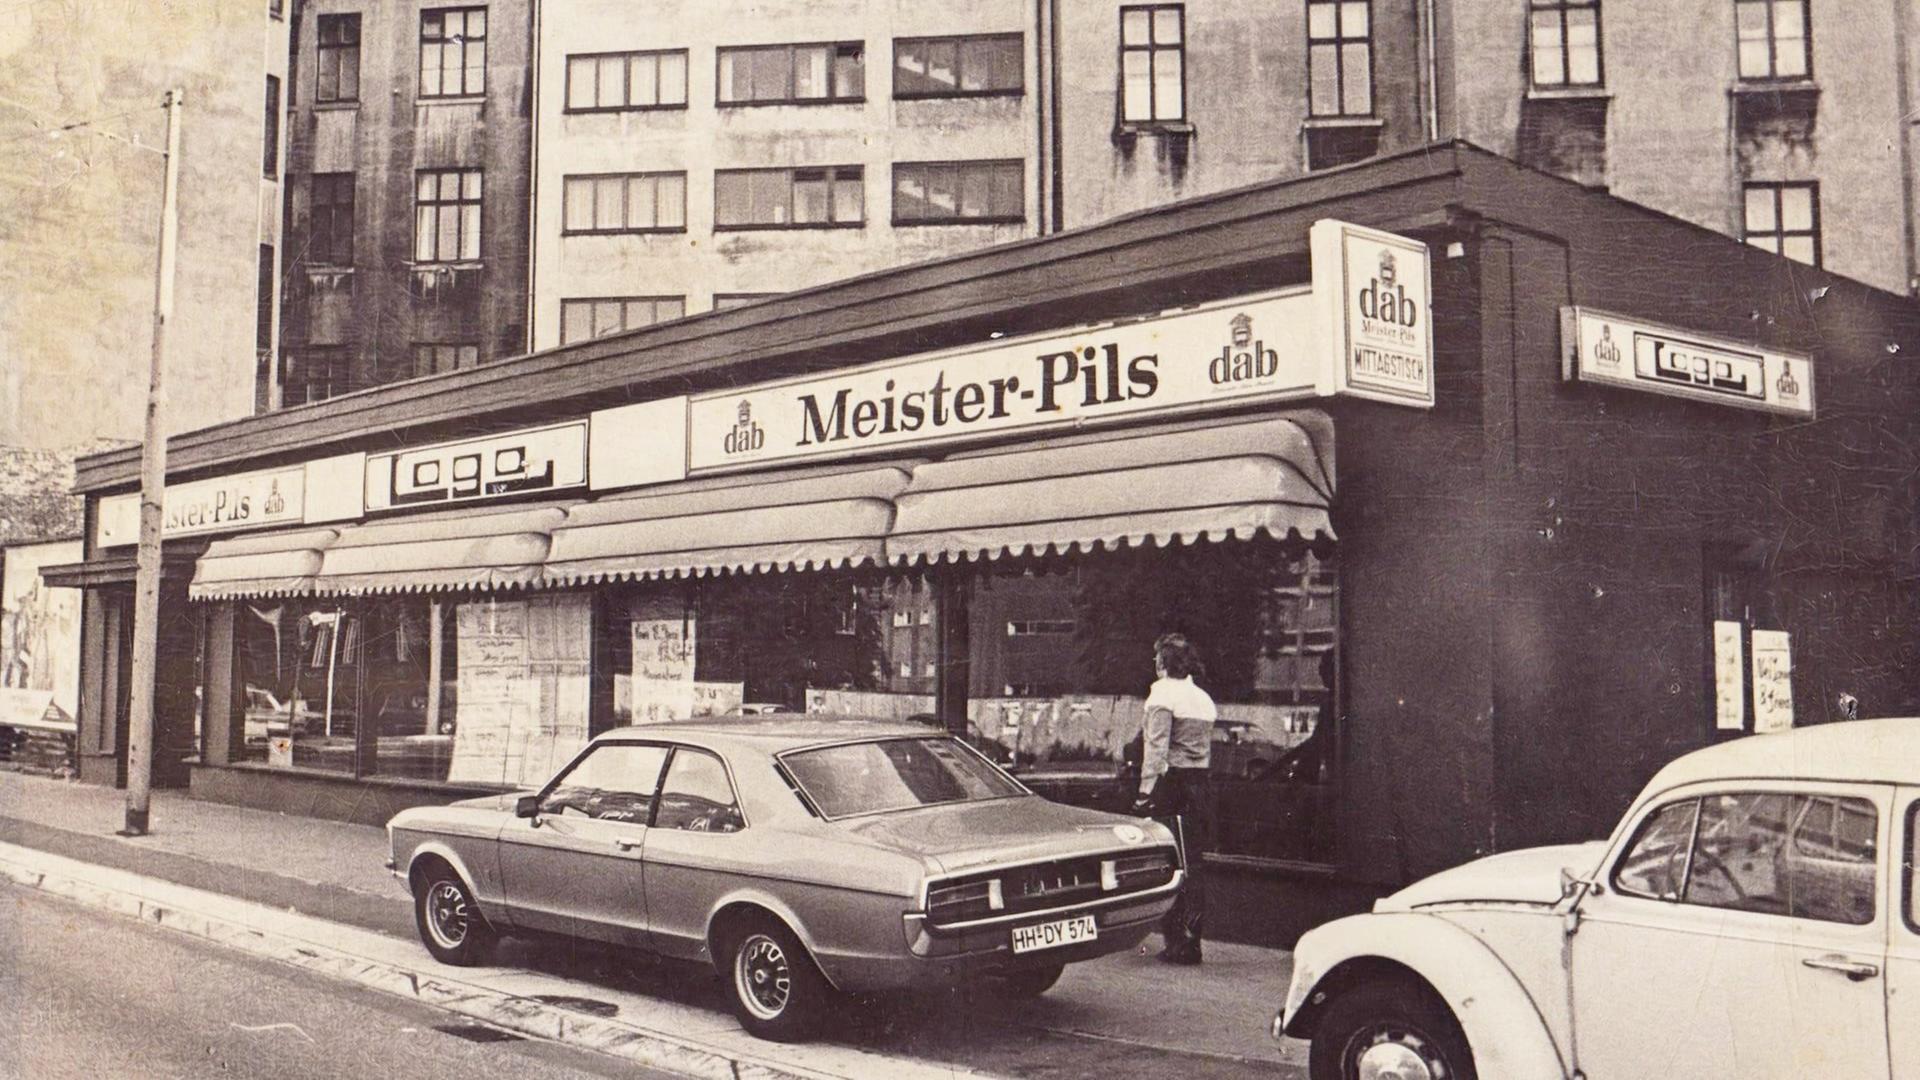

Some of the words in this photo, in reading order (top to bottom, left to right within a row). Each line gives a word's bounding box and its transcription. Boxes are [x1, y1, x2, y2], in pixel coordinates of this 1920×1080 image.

[1359, 278, 1417, 328] dab
[1208, 340, 1279, 385] dab
[1354, 347, 1424, 381] MITTAGSTISCH
[1594, 339, 1621, 362] dab
[796, 343, 1159, 447] Meister-Pils
[1776, 373, 1800, 396] dab
[724, 421, 765, 454] dab
[1069, 917, 1095, 940] 574
